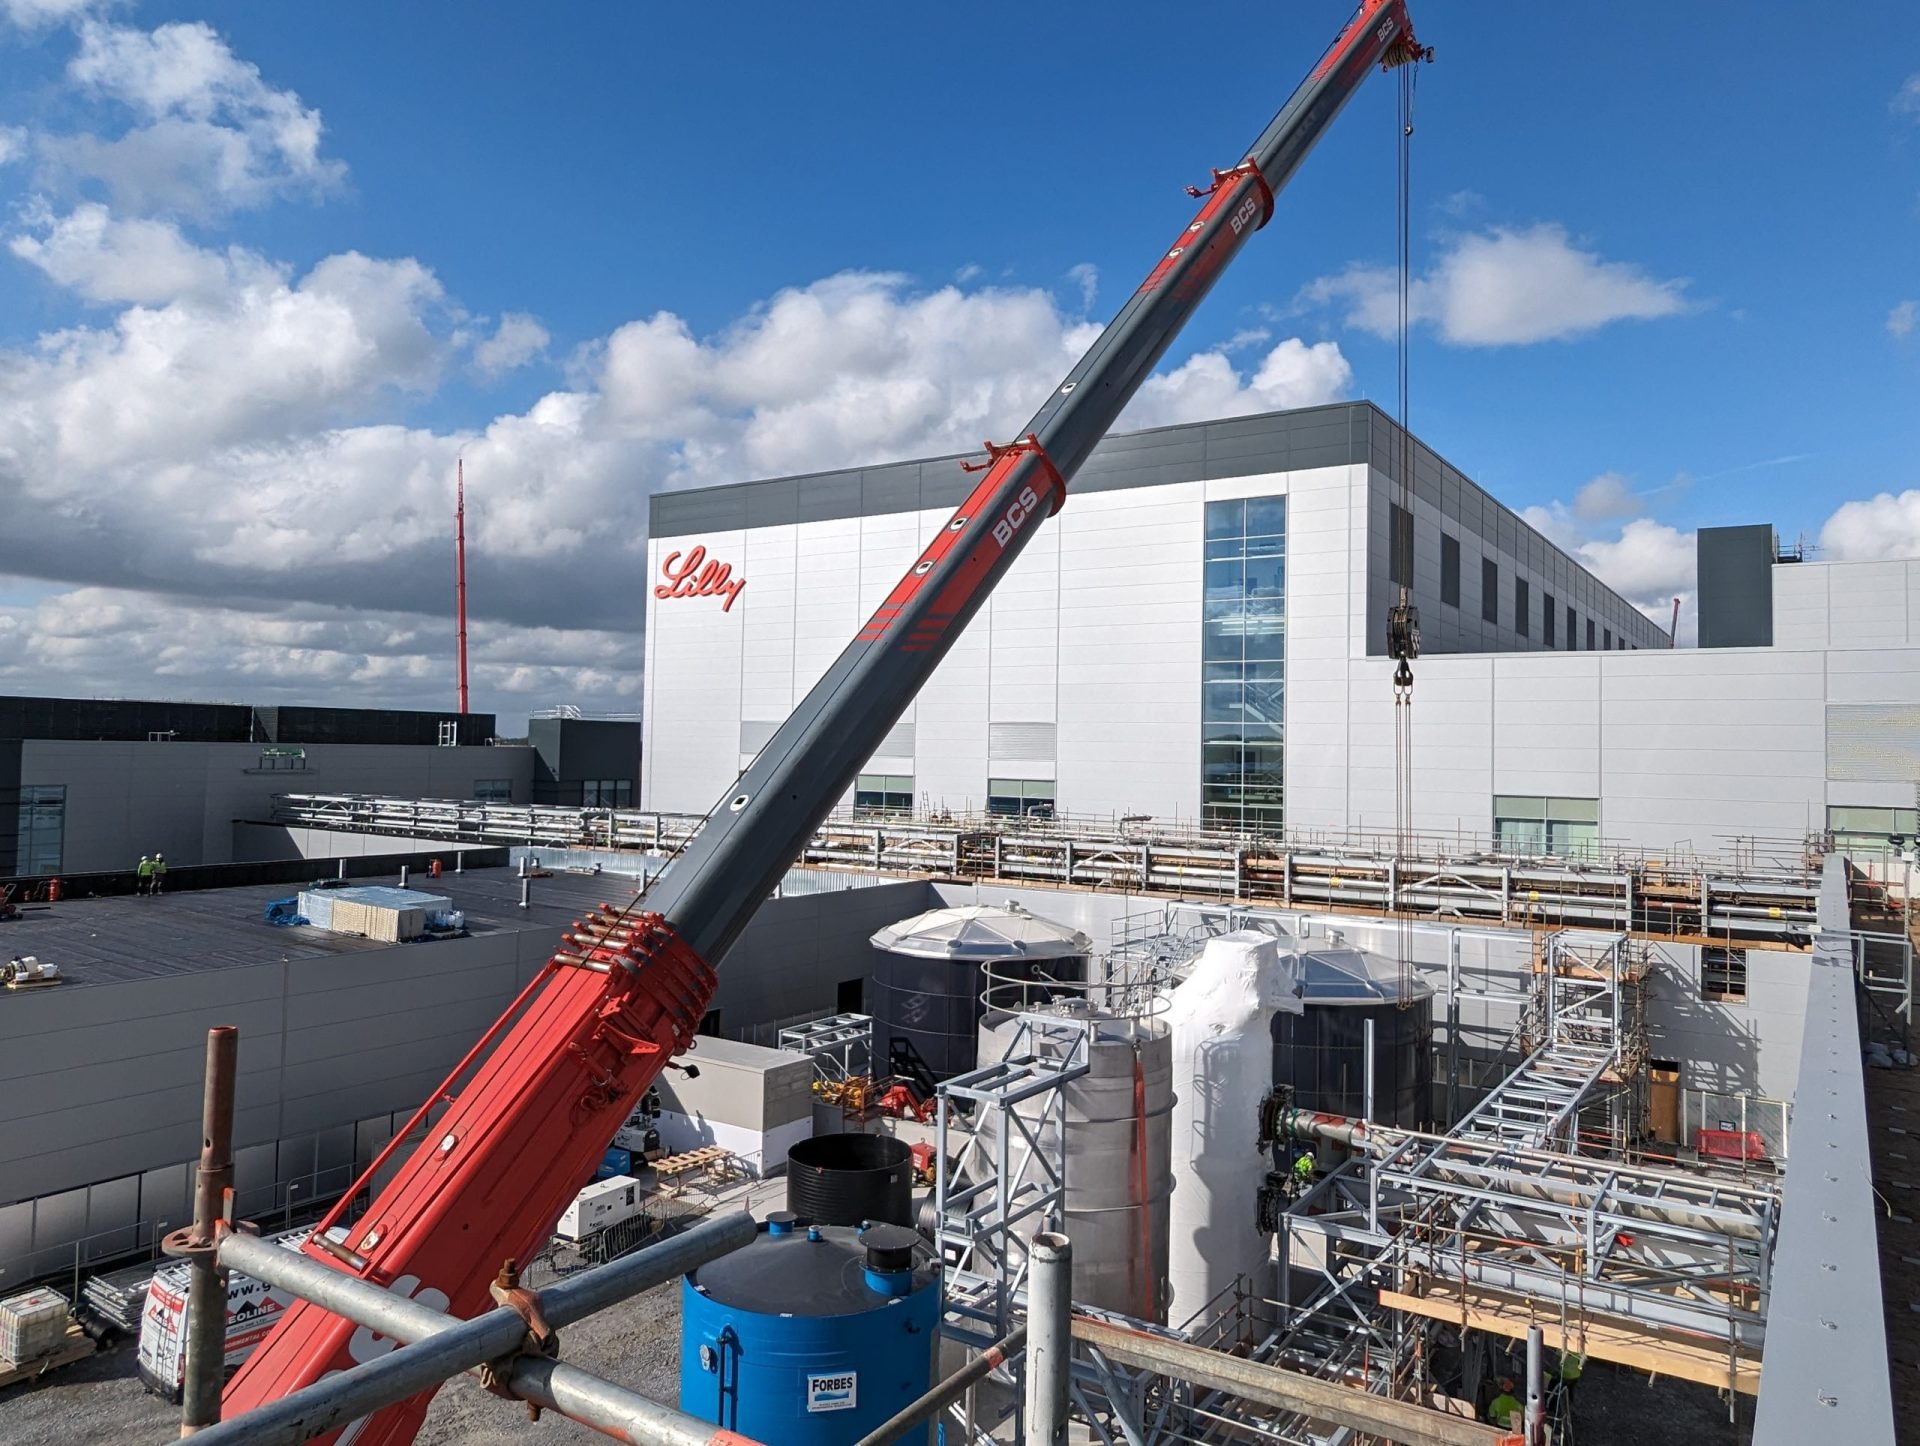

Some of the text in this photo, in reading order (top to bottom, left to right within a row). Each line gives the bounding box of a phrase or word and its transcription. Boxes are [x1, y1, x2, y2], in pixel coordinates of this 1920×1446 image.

[1377, 17, 1394, 42] BCS
[1230, 197, 1256, 235] BCS
[992, 486, 1037, 548] BCS
[654, 545, 747, 613] Lilly
[228, 1302, 276, 1324] EOLINE
[812, 1377, 853, 1392] FORBES
